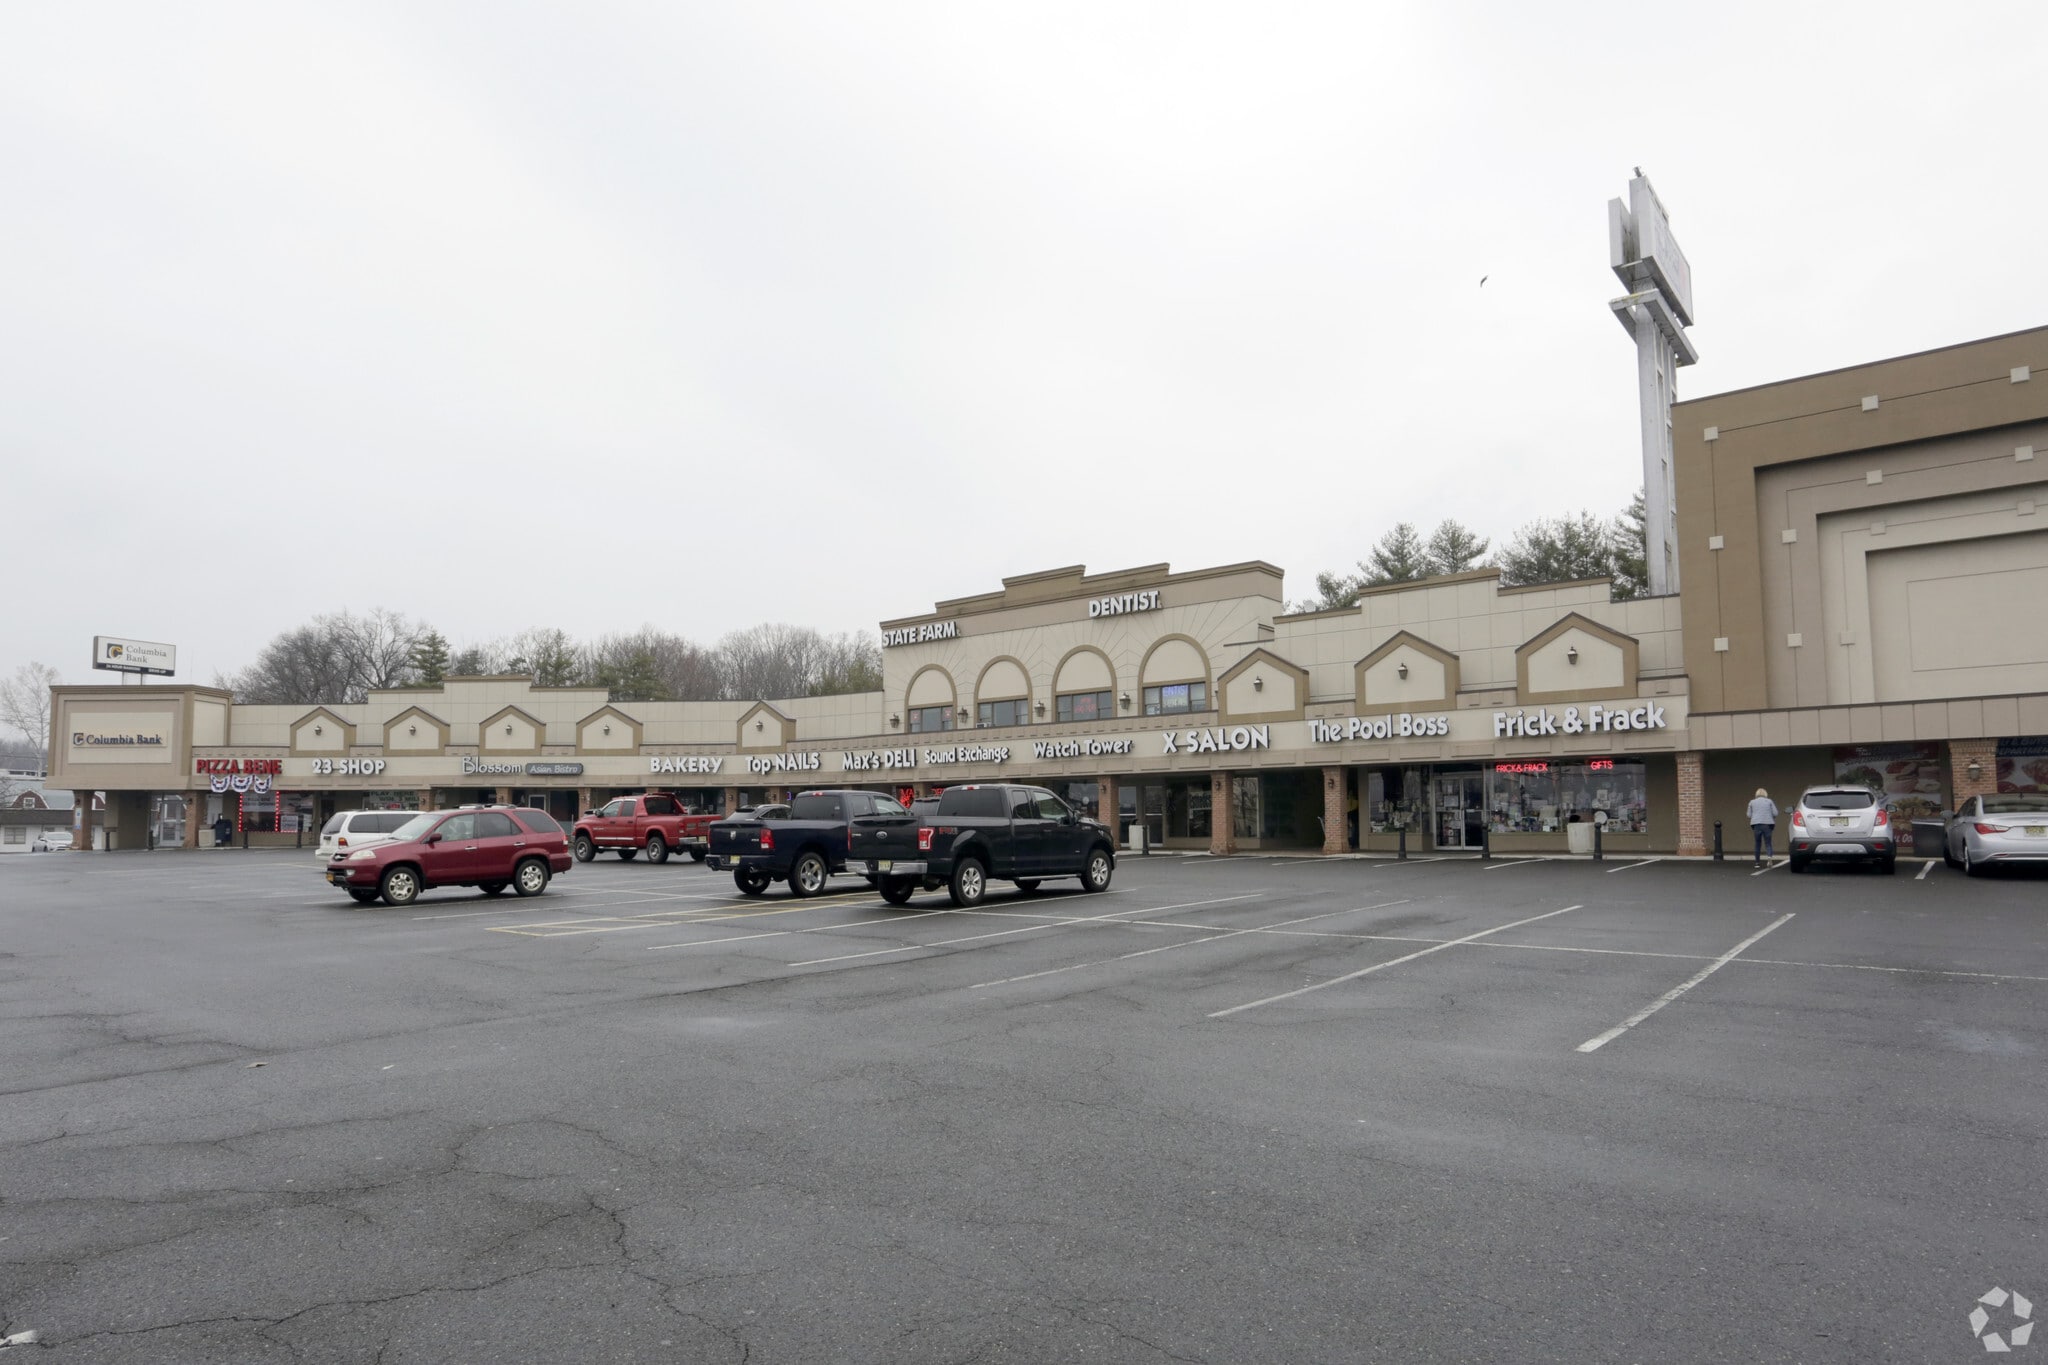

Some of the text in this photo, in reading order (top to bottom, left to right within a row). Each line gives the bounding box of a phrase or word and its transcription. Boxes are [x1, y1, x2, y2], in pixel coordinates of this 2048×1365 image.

[1088, 590, 1160, 618] DENTIST
[881, 621, 957, 648] STATE FARM
[126, 645, 167, 657] Columbia
[126, 654, 148, 663] Bank
[1308, 713, 1448, 742] The Pool Boss
[1493, 701, 1666, 737] Frick & Frack
[86, 734, 162, 745] Columbia Bank
[1162, 725, 1269, 754] X SALON
[924, 746, 1009, 765] Sound Exchange
[1033, 739, 1132, 759] Watch Tower
[196, 759, 282, 774] PIZZA BENE
[312, 759, 386, 774] 23 SHOP
[462, 756, 522, 774] Blossom
[650, 757, 723, 773] BAKERY
[745, 752, 820, 775] Top NAILS
[842, 749, 917, 770] Max's DELI
[1590, 761, 1613, 770] GIFTS
[530, 765, 578, 773] Asian Bistro
